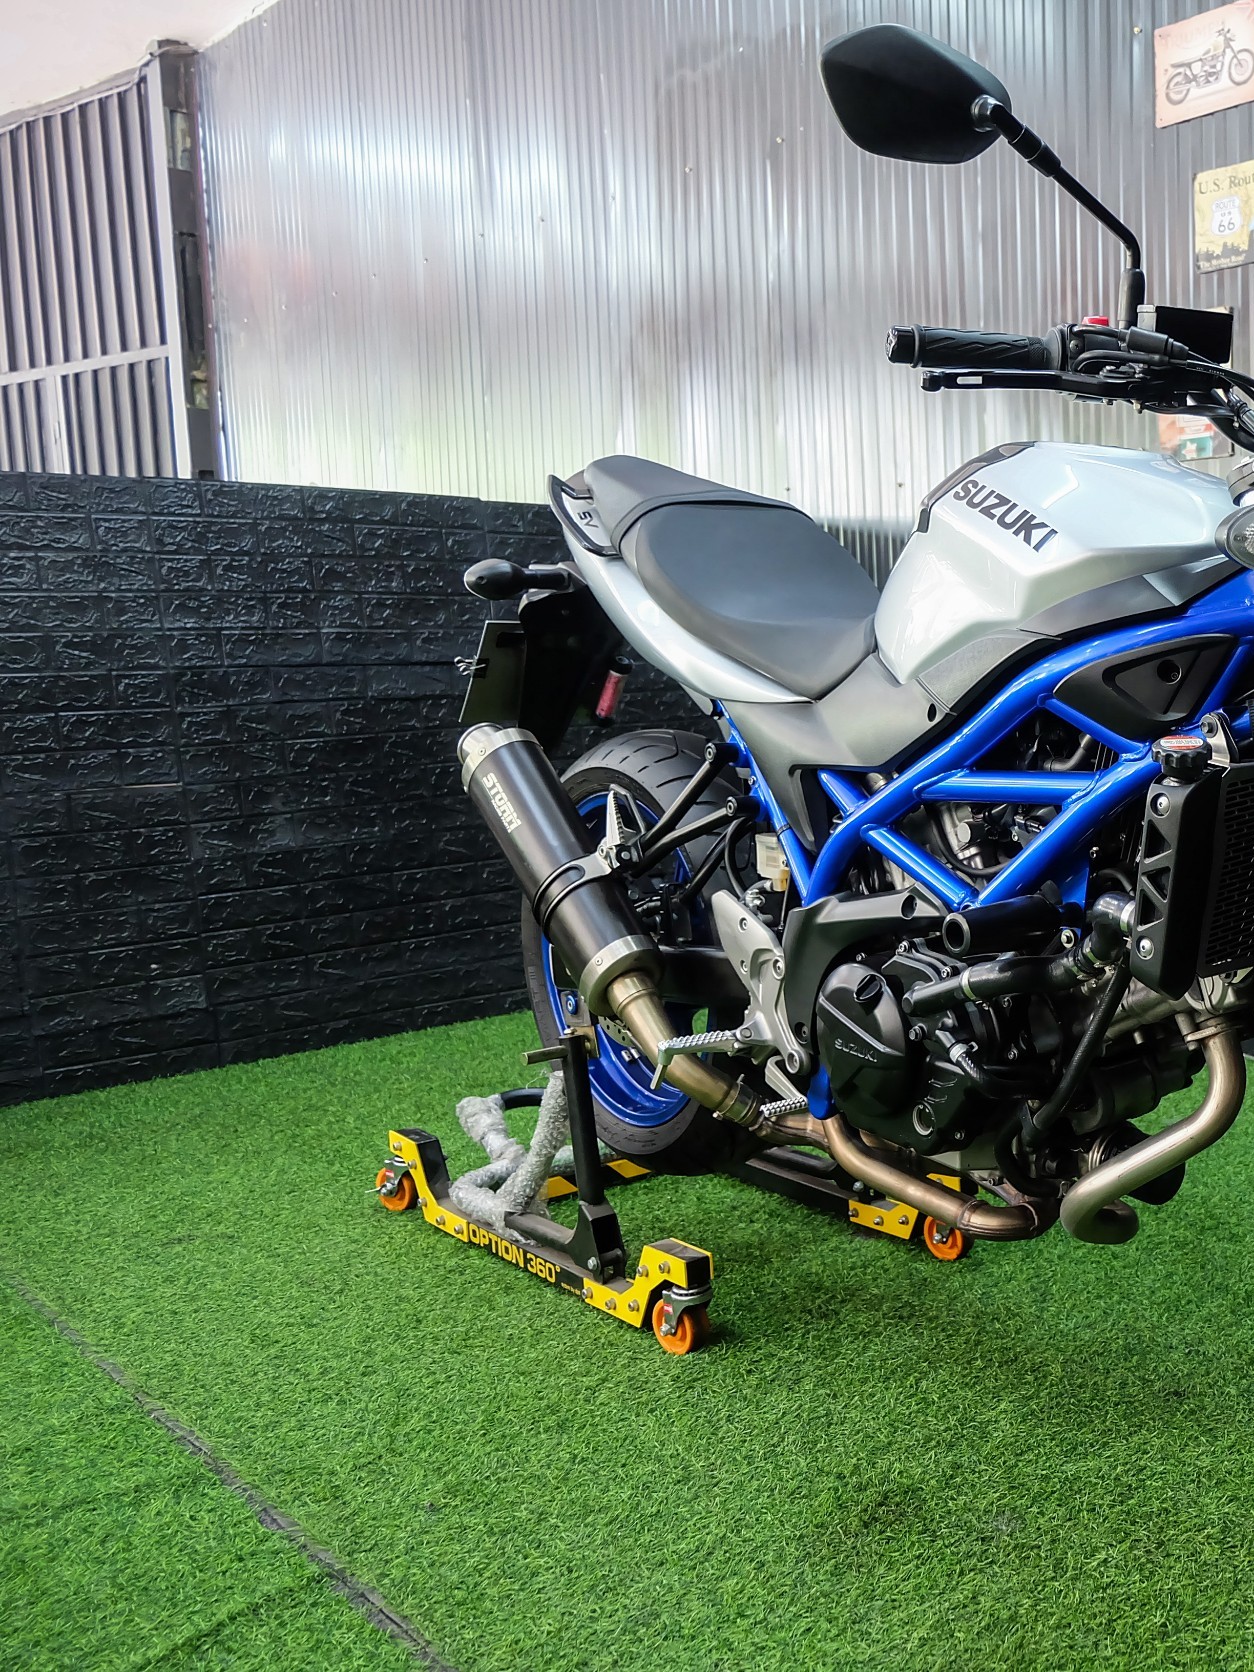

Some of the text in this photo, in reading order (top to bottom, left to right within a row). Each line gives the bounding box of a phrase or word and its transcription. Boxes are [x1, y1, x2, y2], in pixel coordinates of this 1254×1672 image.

[1198, 178, 1224, 195] U.S.
[1215, 200, 1236, 210] ROUTE
[1218, 217, 1236, 233] 66
[577, 511, 599, 528] SV
[953, 479, 1059, 553] SUZUKI
[482, 772, 522, 831] STORM
[834, 1038, 877, 1062] SUZUKI
[469, 1223, 561, 1283] OPTION 360°
